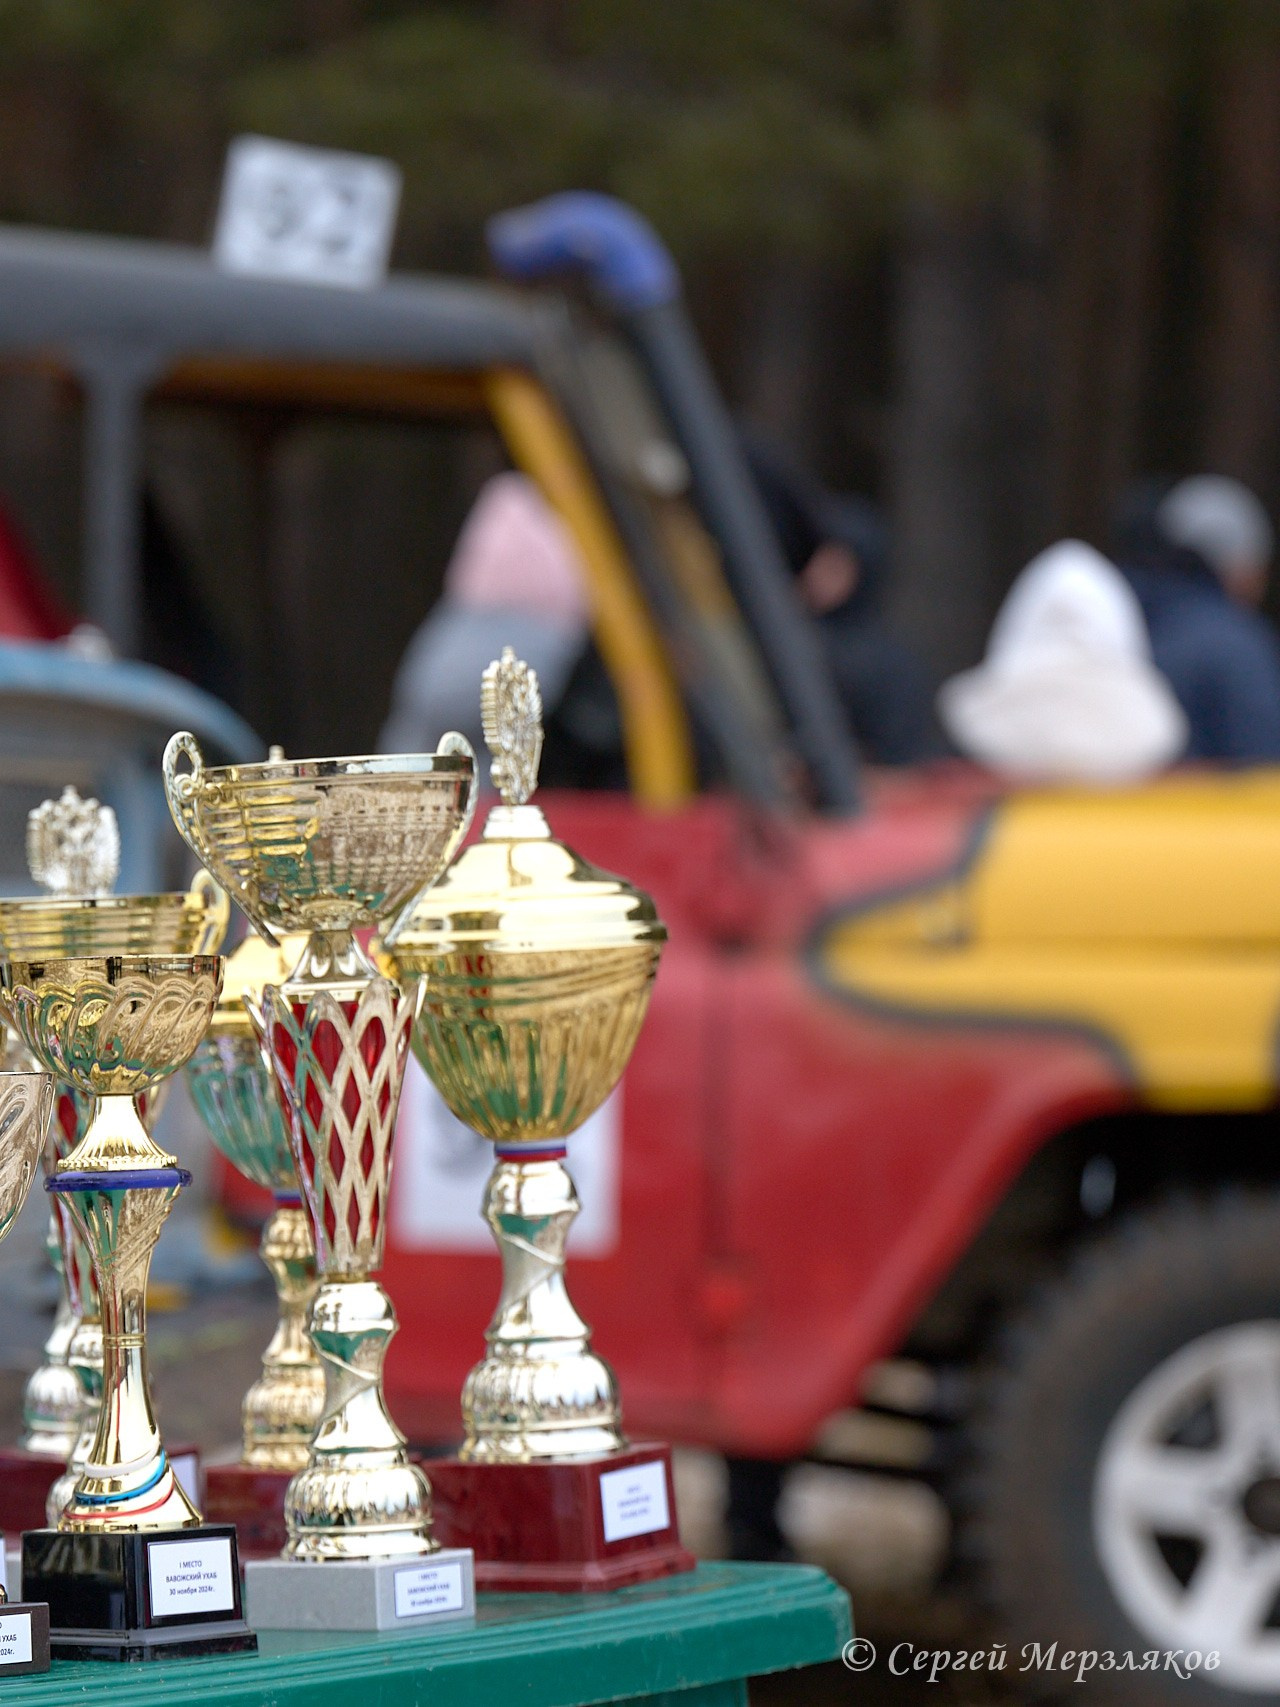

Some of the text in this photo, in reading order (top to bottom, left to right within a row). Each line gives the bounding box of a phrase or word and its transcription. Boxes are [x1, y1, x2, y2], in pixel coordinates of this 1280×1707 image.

[183, 1560, 202, 1568] МЕСТО
[166, 1572, 217, 1583] ВАВОЖСКИЙ УХАБ
[177, 1587, 197, 1595] ноября
[2, 1634, 17, 1642] УХАБ
